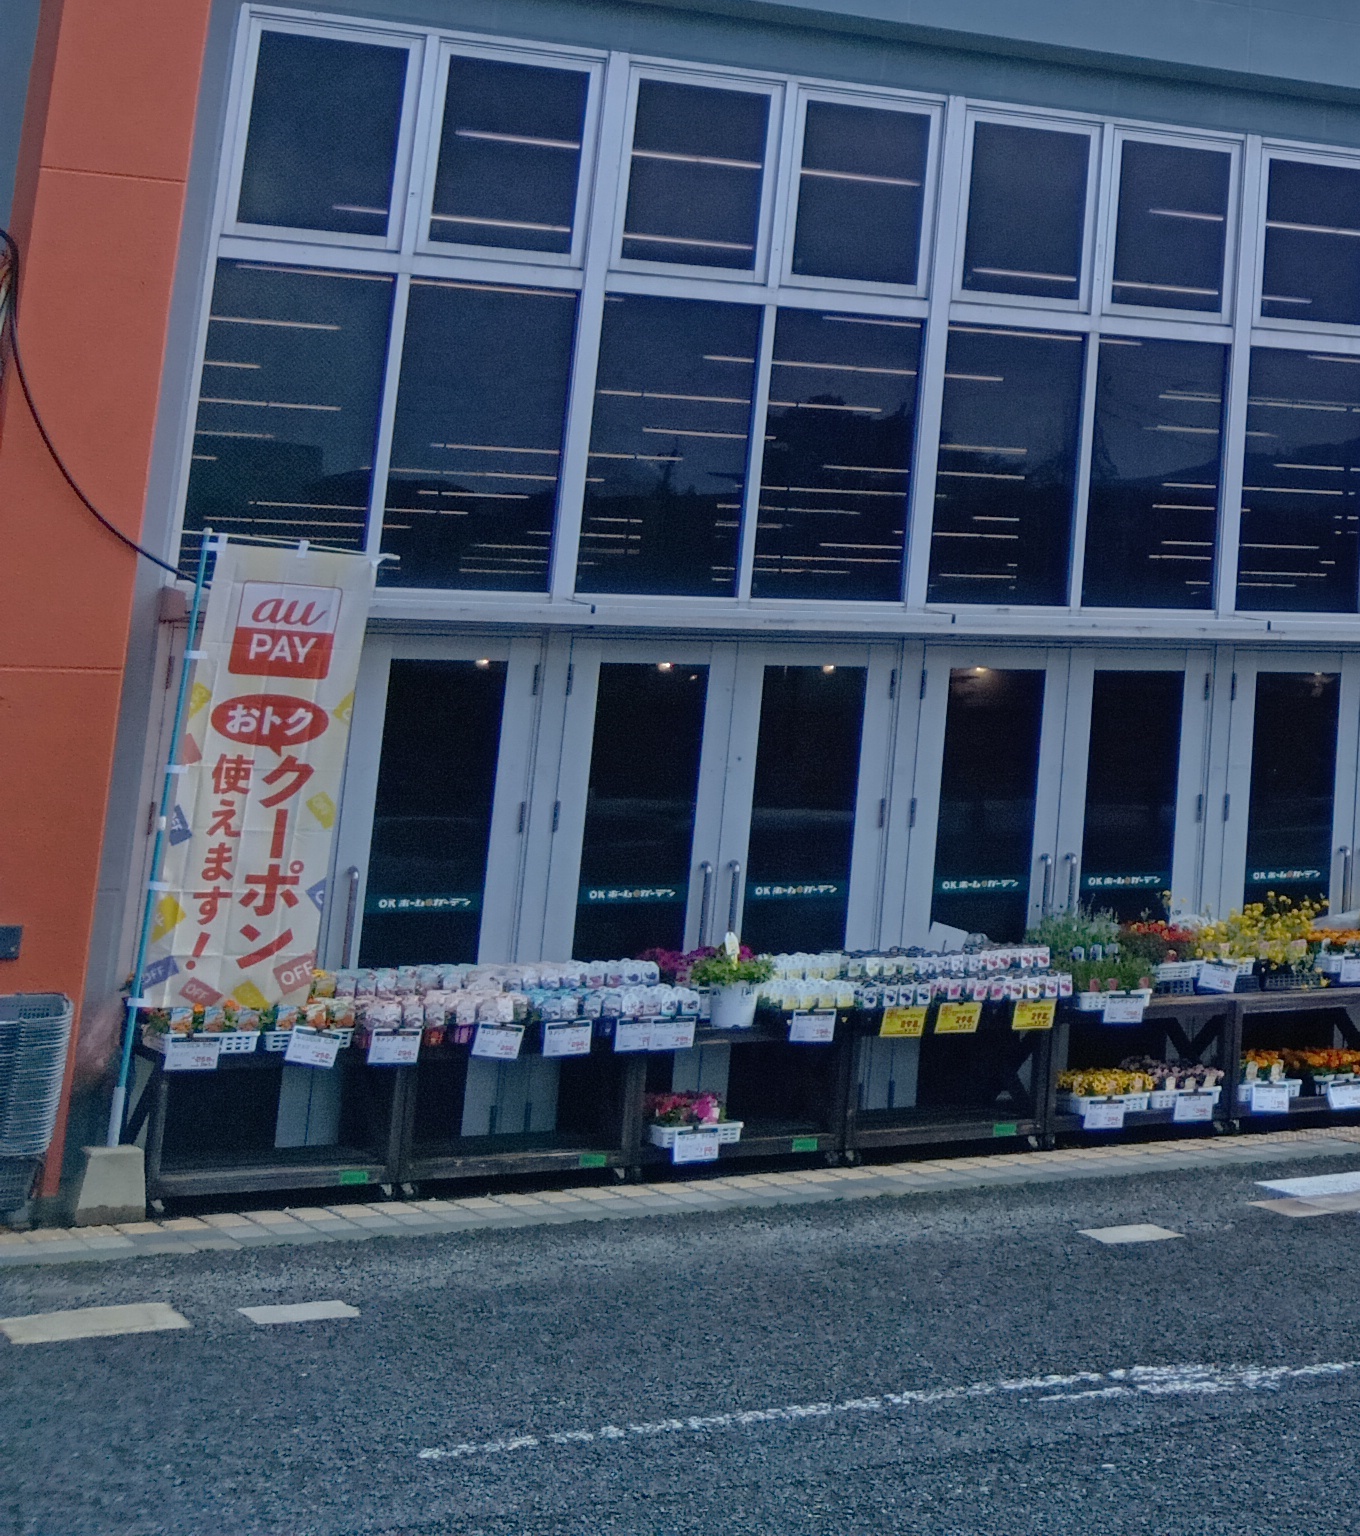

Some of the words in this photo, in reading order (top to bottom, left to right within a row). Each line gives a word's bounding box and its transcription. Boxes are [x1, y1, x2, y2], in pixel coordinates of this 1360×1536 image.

[251, 598, 328, 626] au
[249, 633, 318, 664] PAY
[226, 704, 314, 736] おトク
[235, 754, 315, 970] クーポン
[1088, 876, 1102, 885] OK
[1253, 871, 1266, 880] OK
[755, 886, 770, 895] OK
[942, 881, 957, 890] OK
[589, 890, 605, 899] OK
[379, 899, 396, 909] OK
[280, 959, 314, 985] OFF
[185, 982, 210, 1000] OFF
